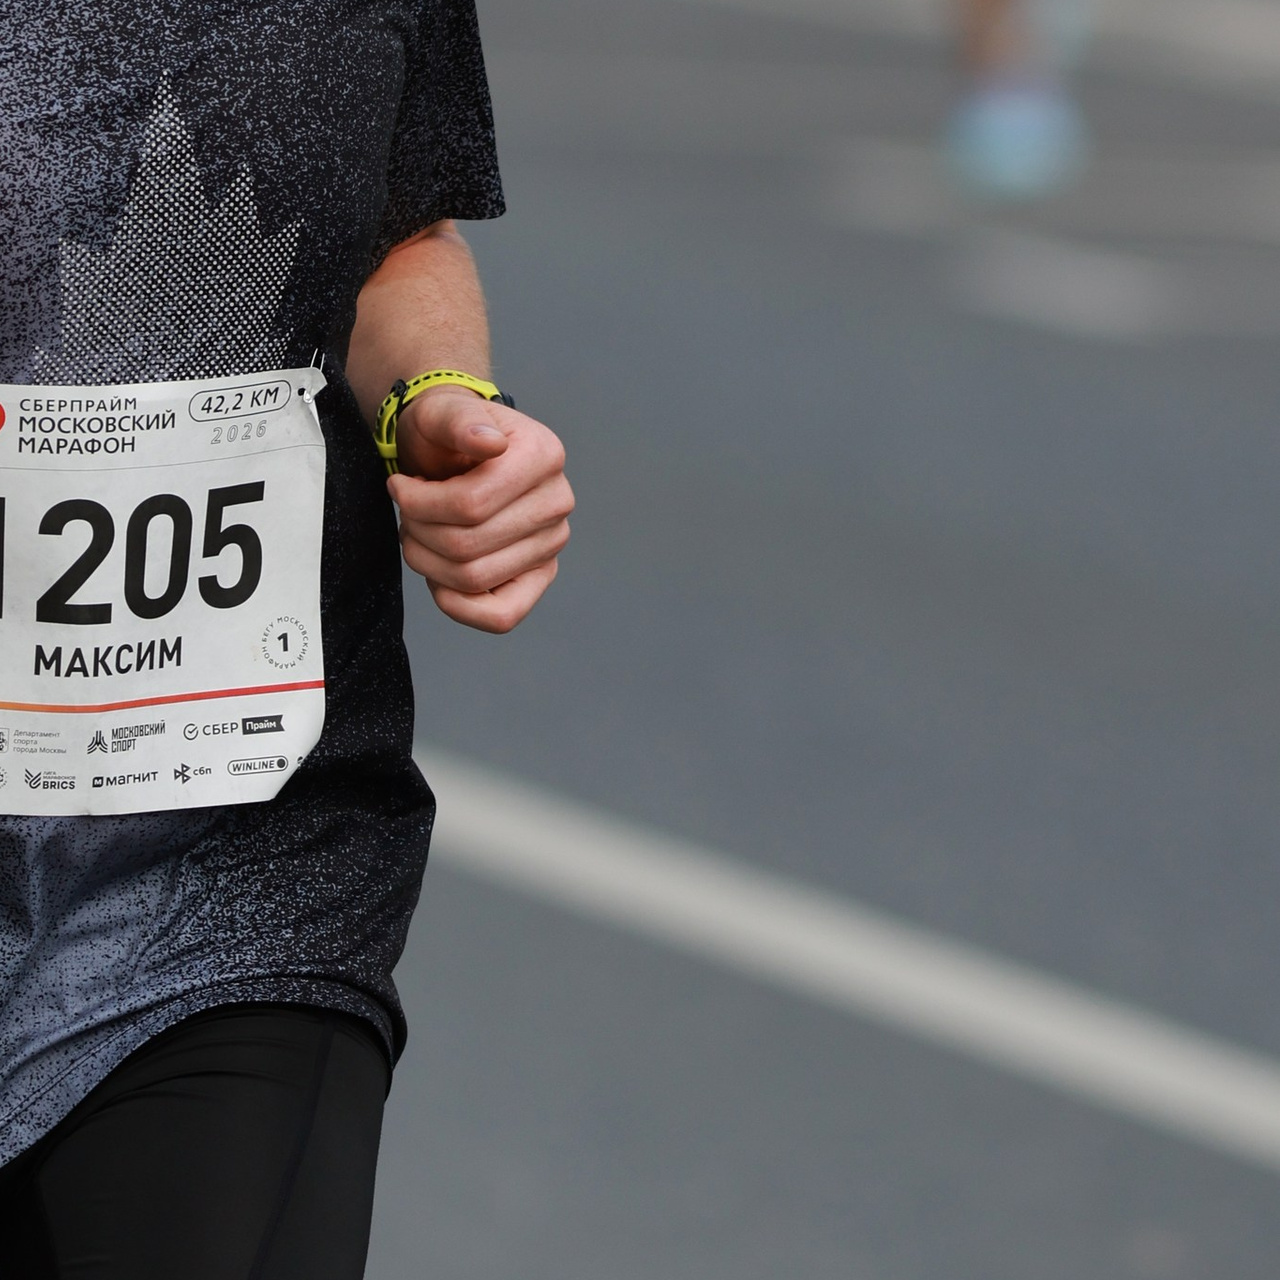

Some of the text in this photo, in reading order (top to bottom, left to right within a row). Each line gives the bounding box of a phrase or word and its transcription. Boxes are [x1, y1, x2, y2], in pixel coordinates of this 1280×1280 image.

[19, 396, 137, 412] СБЕРПРАЙМ
[201, 393, 243, 414] 42,2
[19, 409, 176, 433] МОСКОВСКИЙ
[211, 419, 267, 444] 2026
[18, 436, 135, 454] МАРАФОН
[277, 632, 288, 652] 1
[34, 636, 182, 677] МАКСИМ
[112, 720, 166, 740] МОСКОВСКИЙ
[203, 720, 277, 736] СБЕР Прайм
[111, 738, 136, 753] СПОРТ
[193, 767, 212, 776] сбп
[232, 760, 275, 772] WINLINE
[42, 781, 76, 790] BRICS
